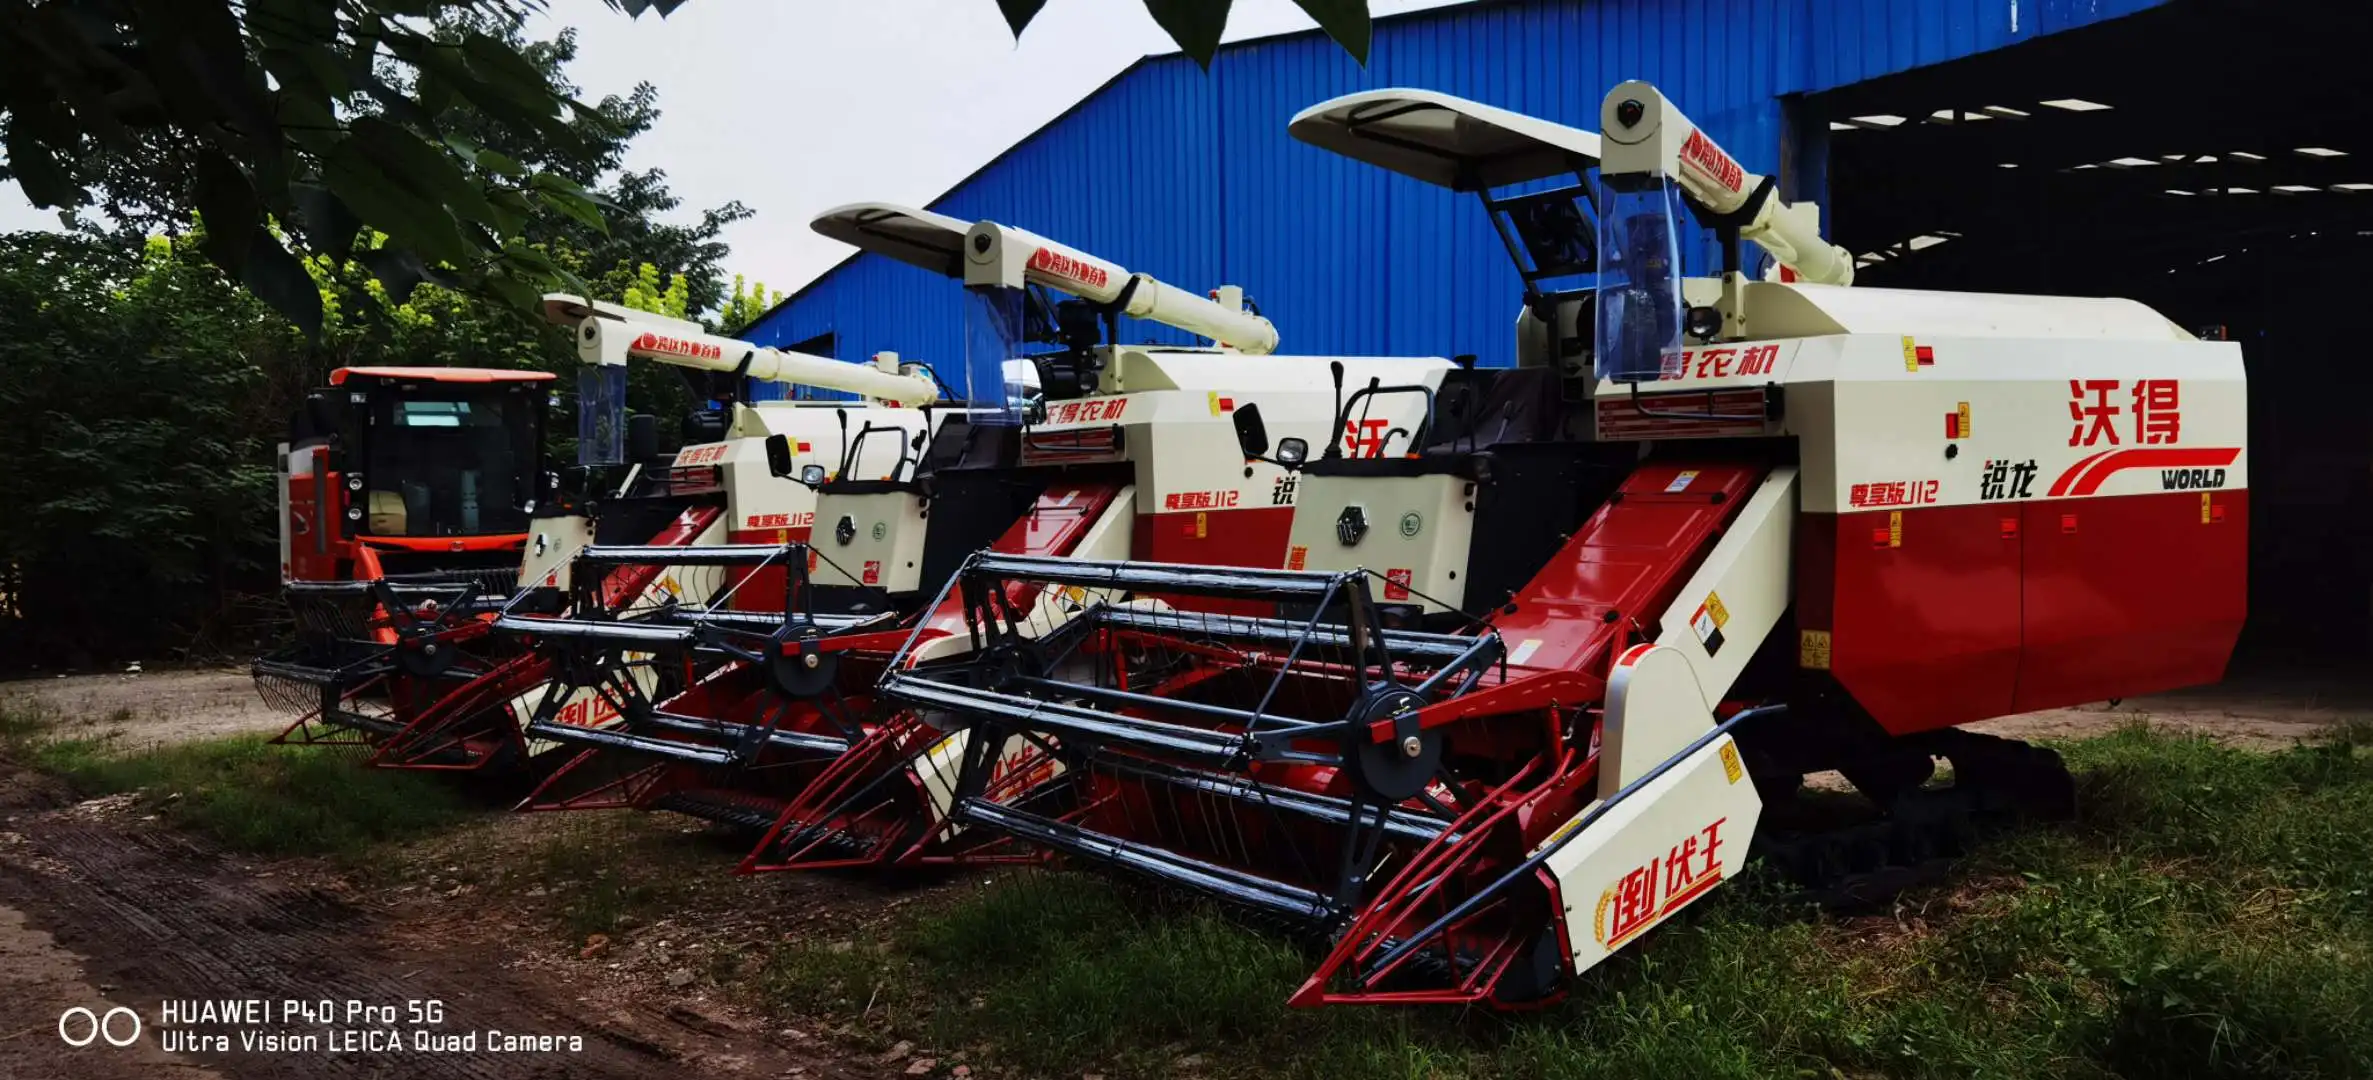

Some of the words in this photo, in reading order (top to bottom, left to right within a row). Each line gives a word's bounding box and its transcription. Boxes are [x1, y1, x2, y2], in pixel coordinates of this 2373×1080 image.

[2068, 379, 2180, 447] 沃得
[1980, 458, 2038, 500] 锐龙
[2161, 468, 2226, 490] WORLD
[1611, 816, 1726, 938] 倒伏王
